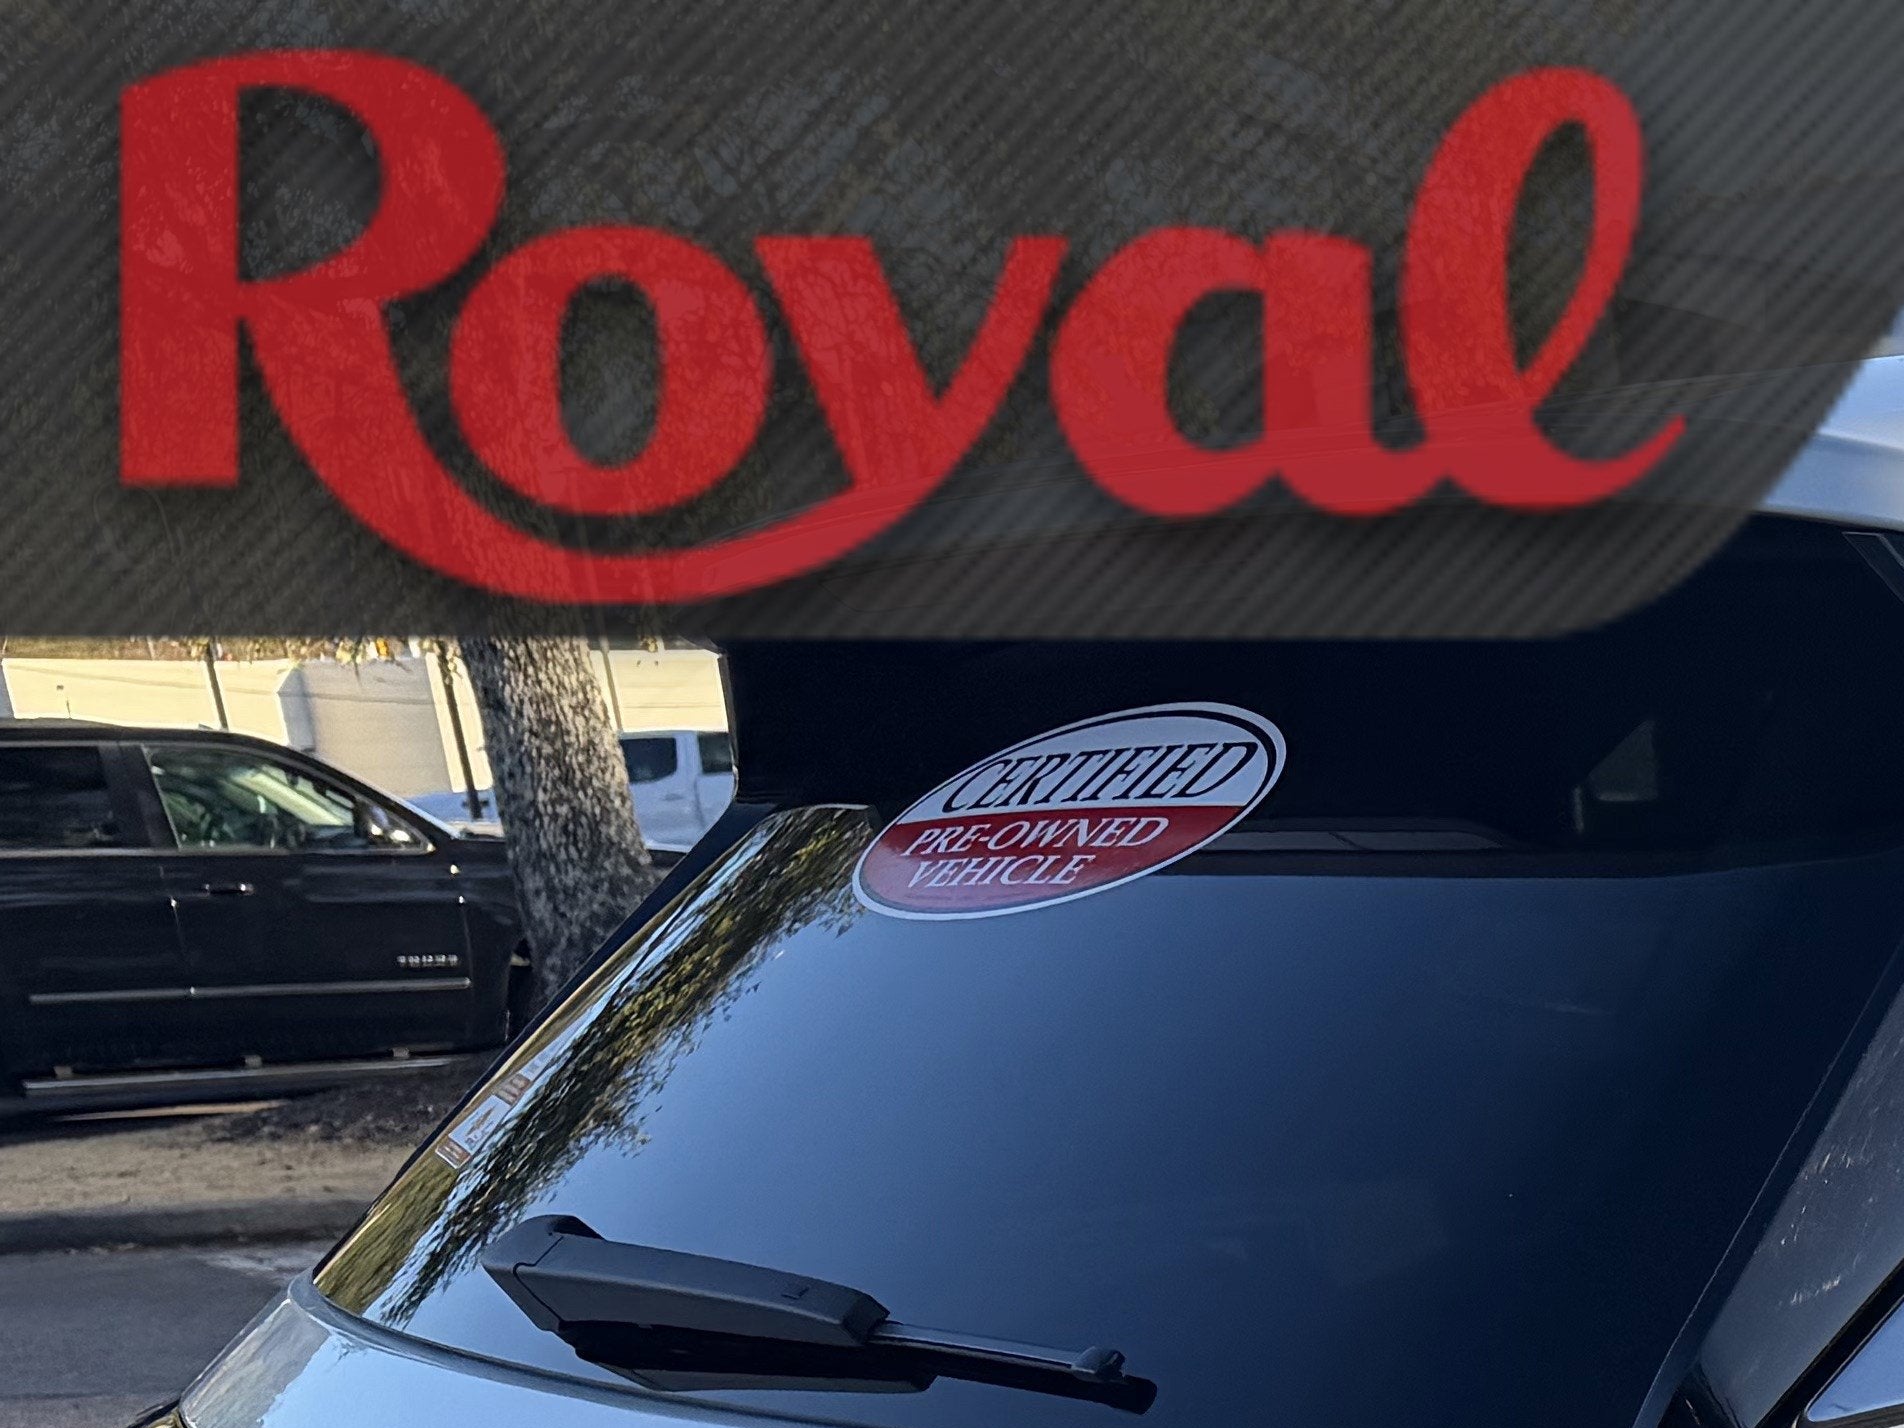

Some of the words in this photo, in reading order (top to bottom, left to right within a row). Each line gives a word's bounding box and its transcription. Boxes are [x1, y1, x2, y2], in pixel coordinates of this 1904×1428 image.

[941, 742, 1259, 813] CERTIFIED
[900, 817, 1169, 857] PRE-OWNED
[906, 854, 1096, 889] VEHICLE
